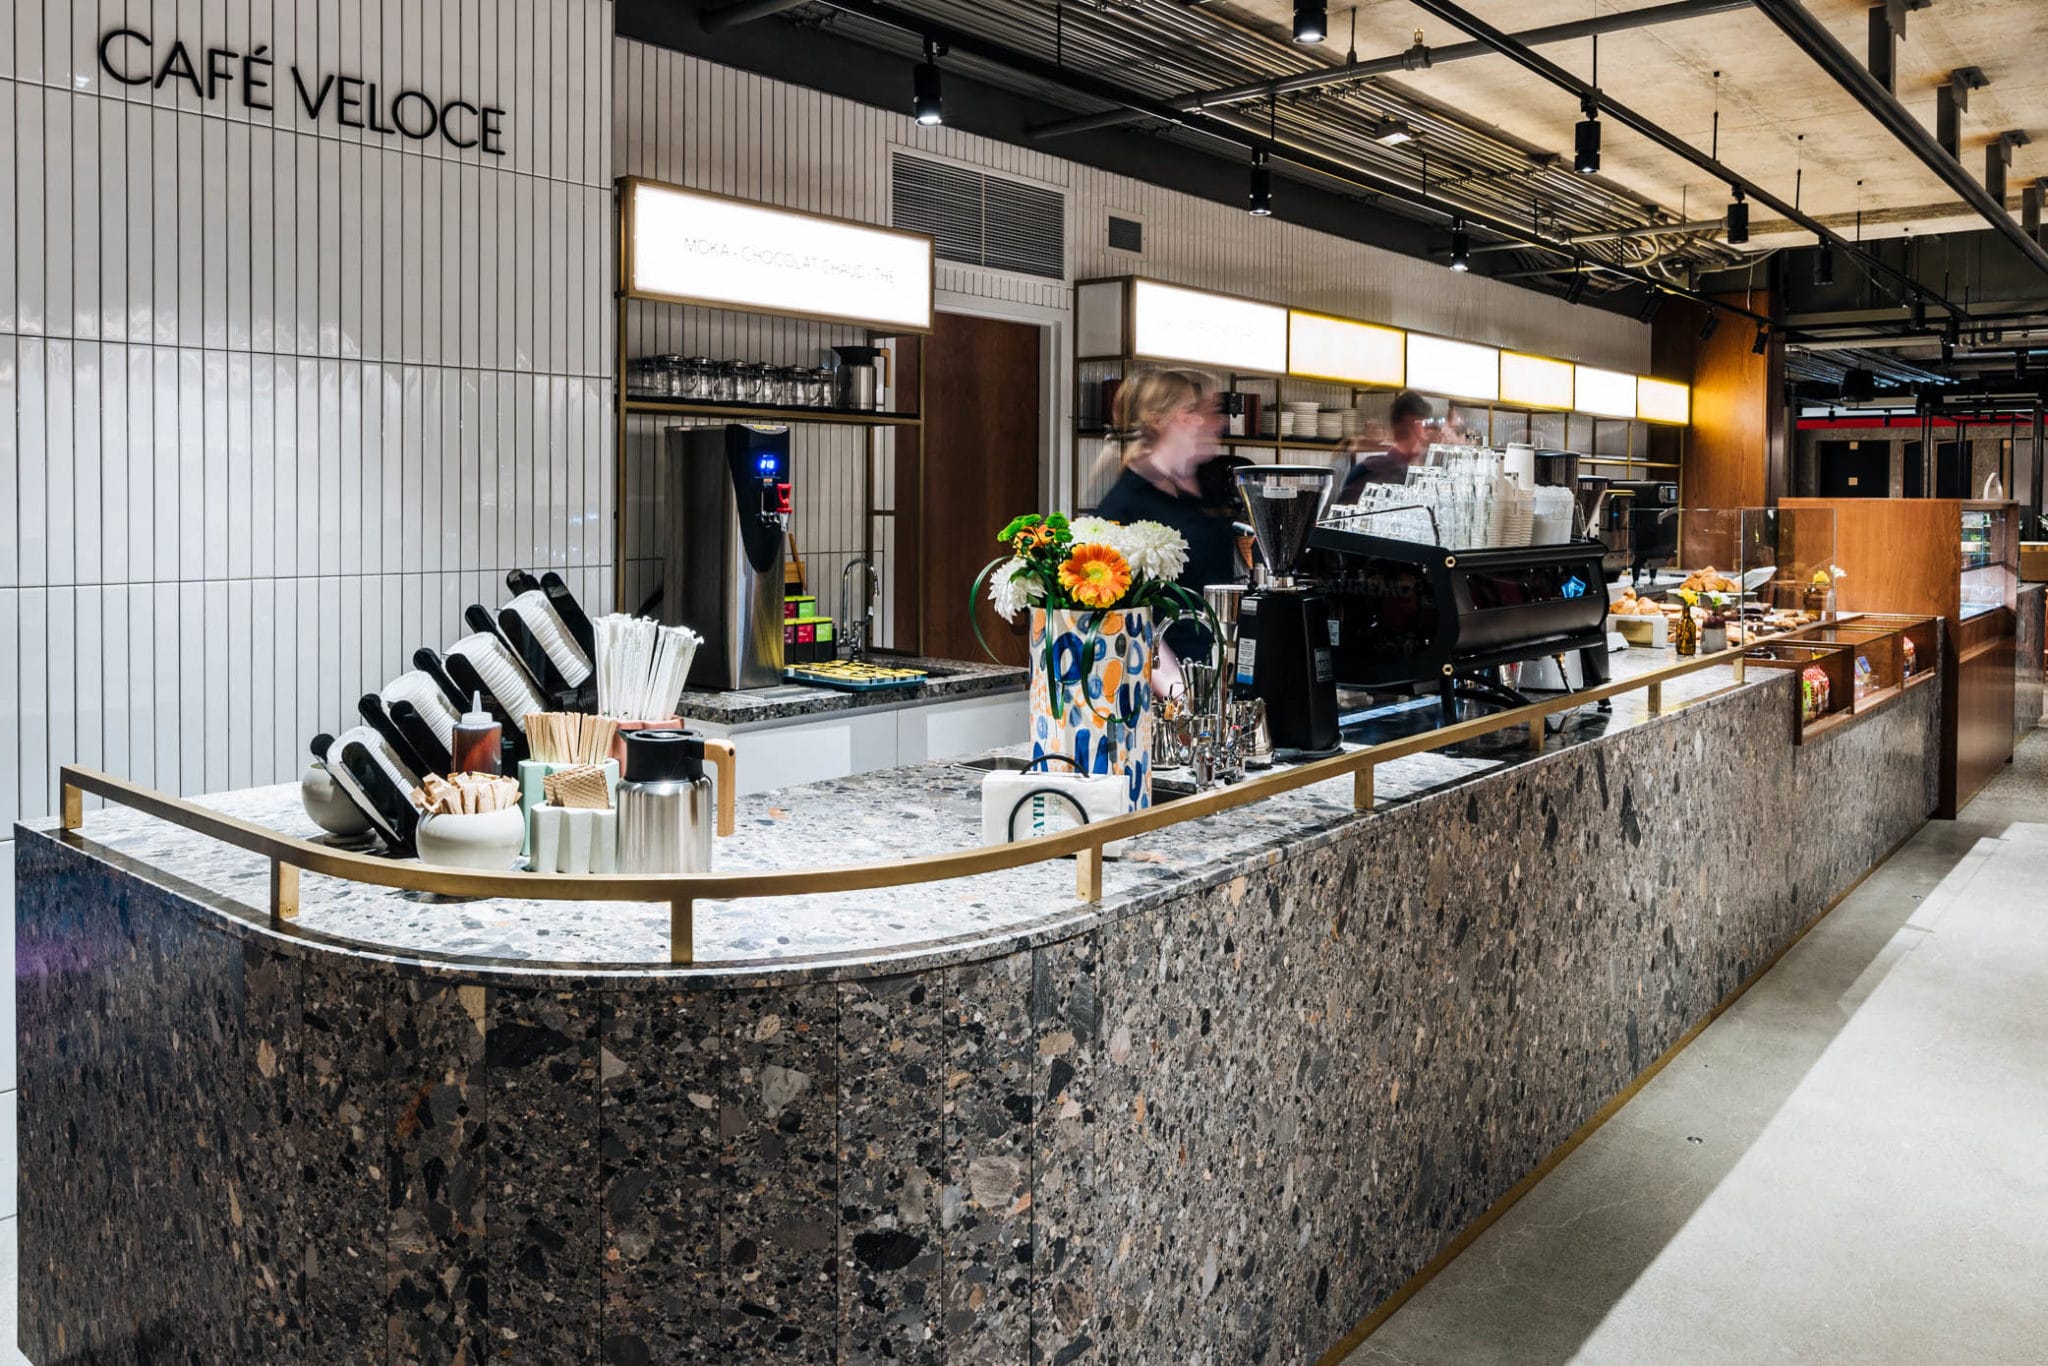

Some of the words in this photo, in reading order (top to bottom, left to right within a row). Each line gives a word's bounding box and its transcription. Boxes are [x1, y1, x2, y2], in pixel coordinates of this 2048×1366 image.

[98, 28, 274, 111] CAFÉ
[291, 65, 506, 156] VELOCE
[684, 237, 729, 256] MOKA
[741, 245, 817, 271] CHOCOLAT
